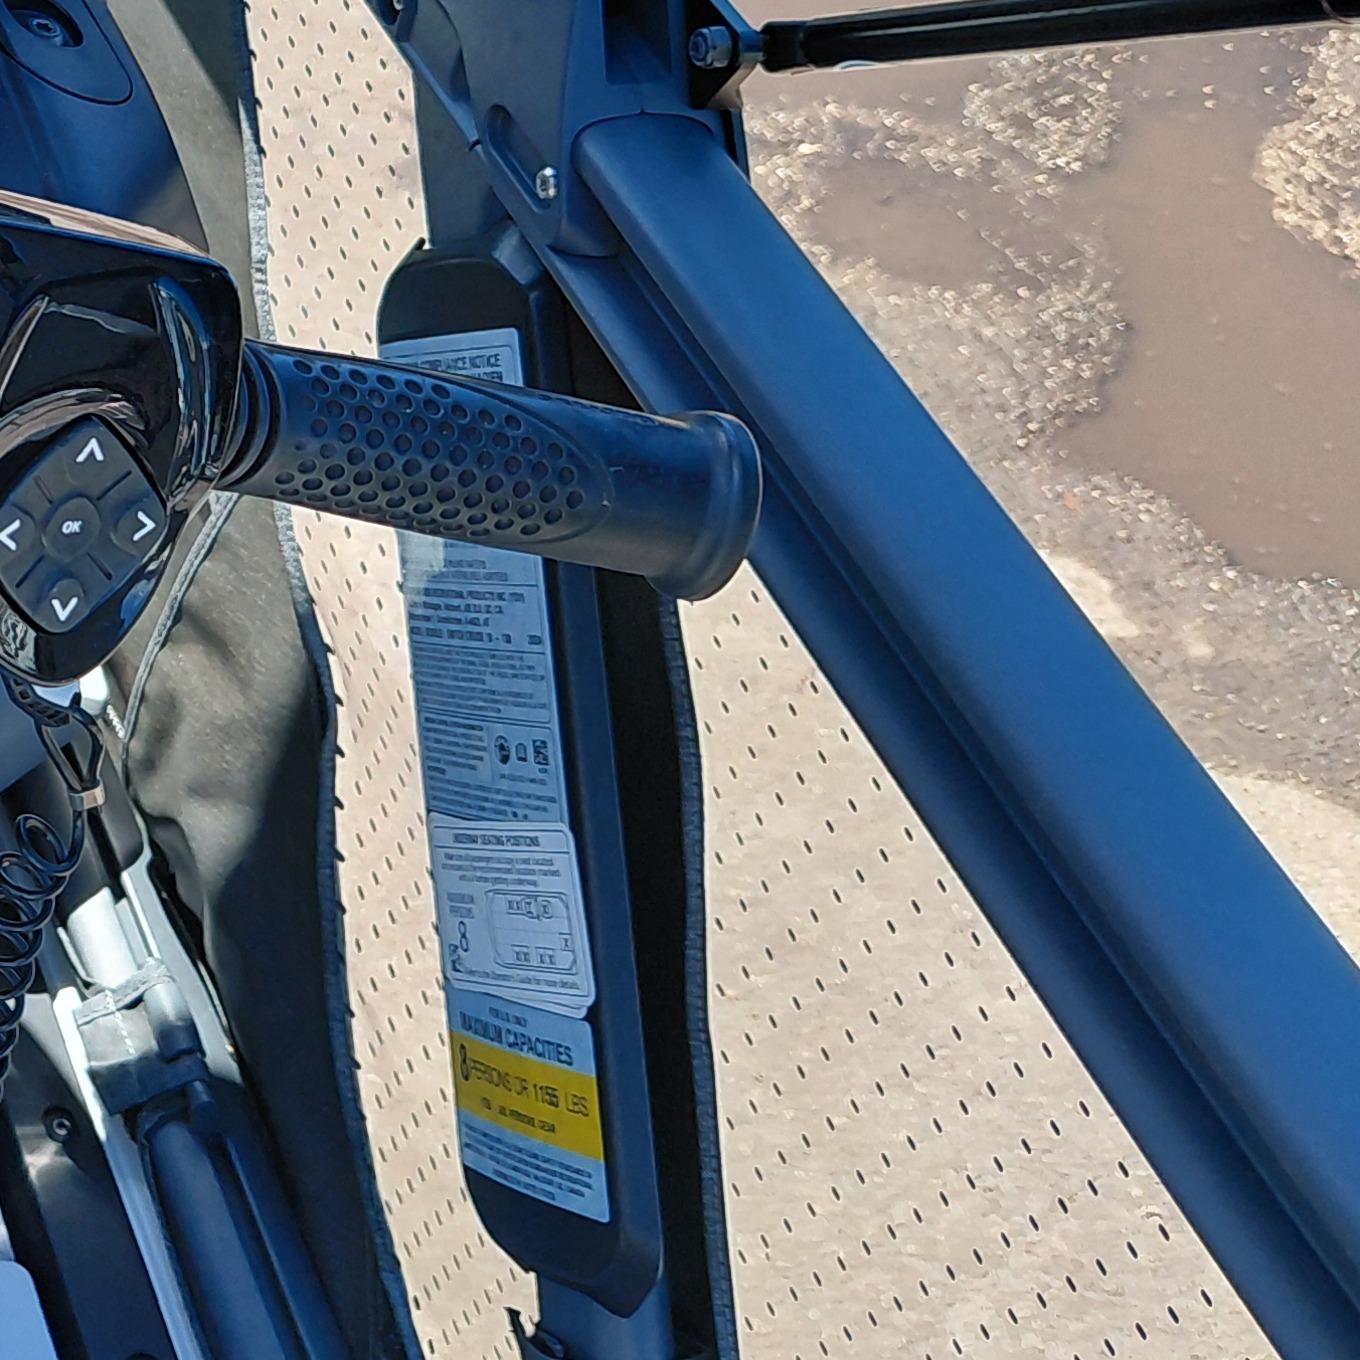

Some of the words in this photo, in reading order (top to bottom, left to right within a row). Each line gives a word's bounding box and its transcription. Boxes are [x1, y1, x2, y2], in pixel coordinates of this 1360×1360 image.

[60, 519, 82, 535] OK
[457, 920, 469, 952] 8
[506, 1028, 574, 1066] CAPACITIES
